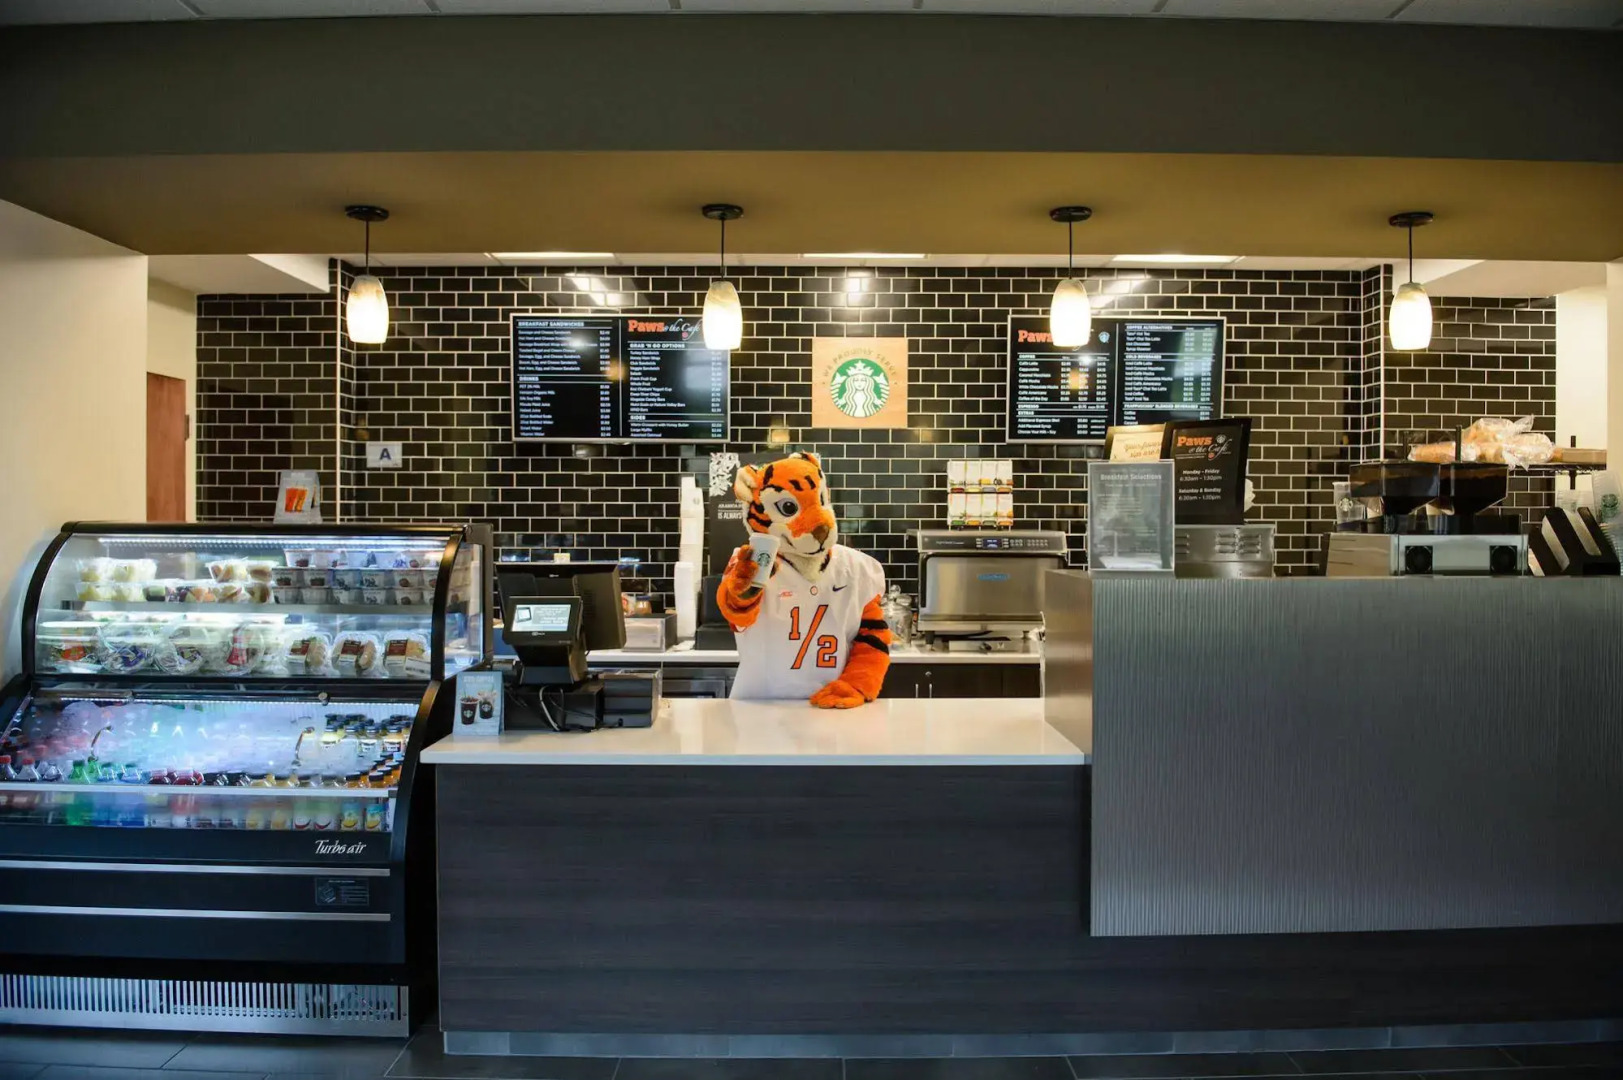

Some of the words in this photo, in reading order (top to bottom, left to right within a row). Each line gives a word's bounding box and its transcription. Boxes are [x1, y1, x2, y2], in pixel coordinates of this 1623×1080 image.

[628, 320, 664, 332] Paws
[669, 319, 680, 332] the
[1177, 436, 1212, 446] Paws
[380, 448, 391, 460] A
[315, 840, 347, 854] Turbo
[346, 842, 366, 854] air
